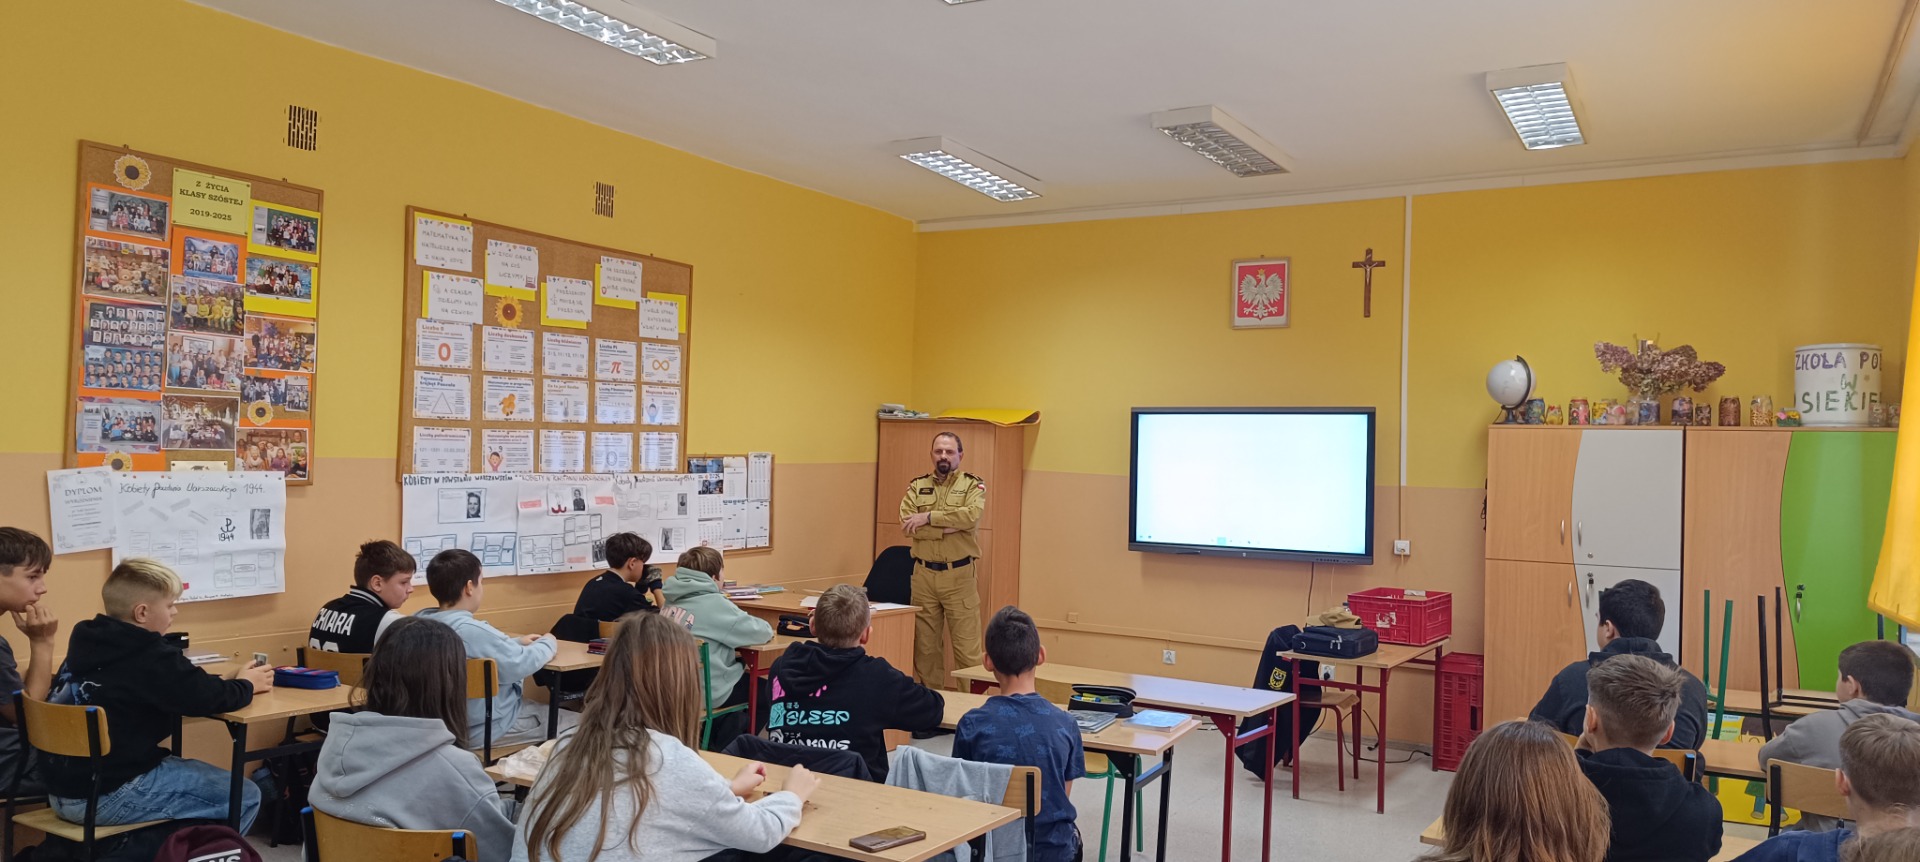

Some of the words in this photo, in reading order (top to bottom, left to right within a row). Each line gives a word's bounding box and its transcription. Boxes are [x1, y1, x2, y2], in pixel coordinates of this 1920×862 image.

[206, 182, 229, 192] ŻYCIA
[179, 188, 206, 199] KLASY
[208, 194, 243, 206] SZÓSTEJ
[190, 208, 232, 221] 2019-2025
[1860, 351, 1882, 371] PO
[1802, 390, 1881, 413] SIEKIE
[65, 486, 102, 496] DYPLOM
[218, 533, 234, 541] 1944
[312, 608, 355, 636] CHIARA
[786, 710, 850, 725] SLEEP
